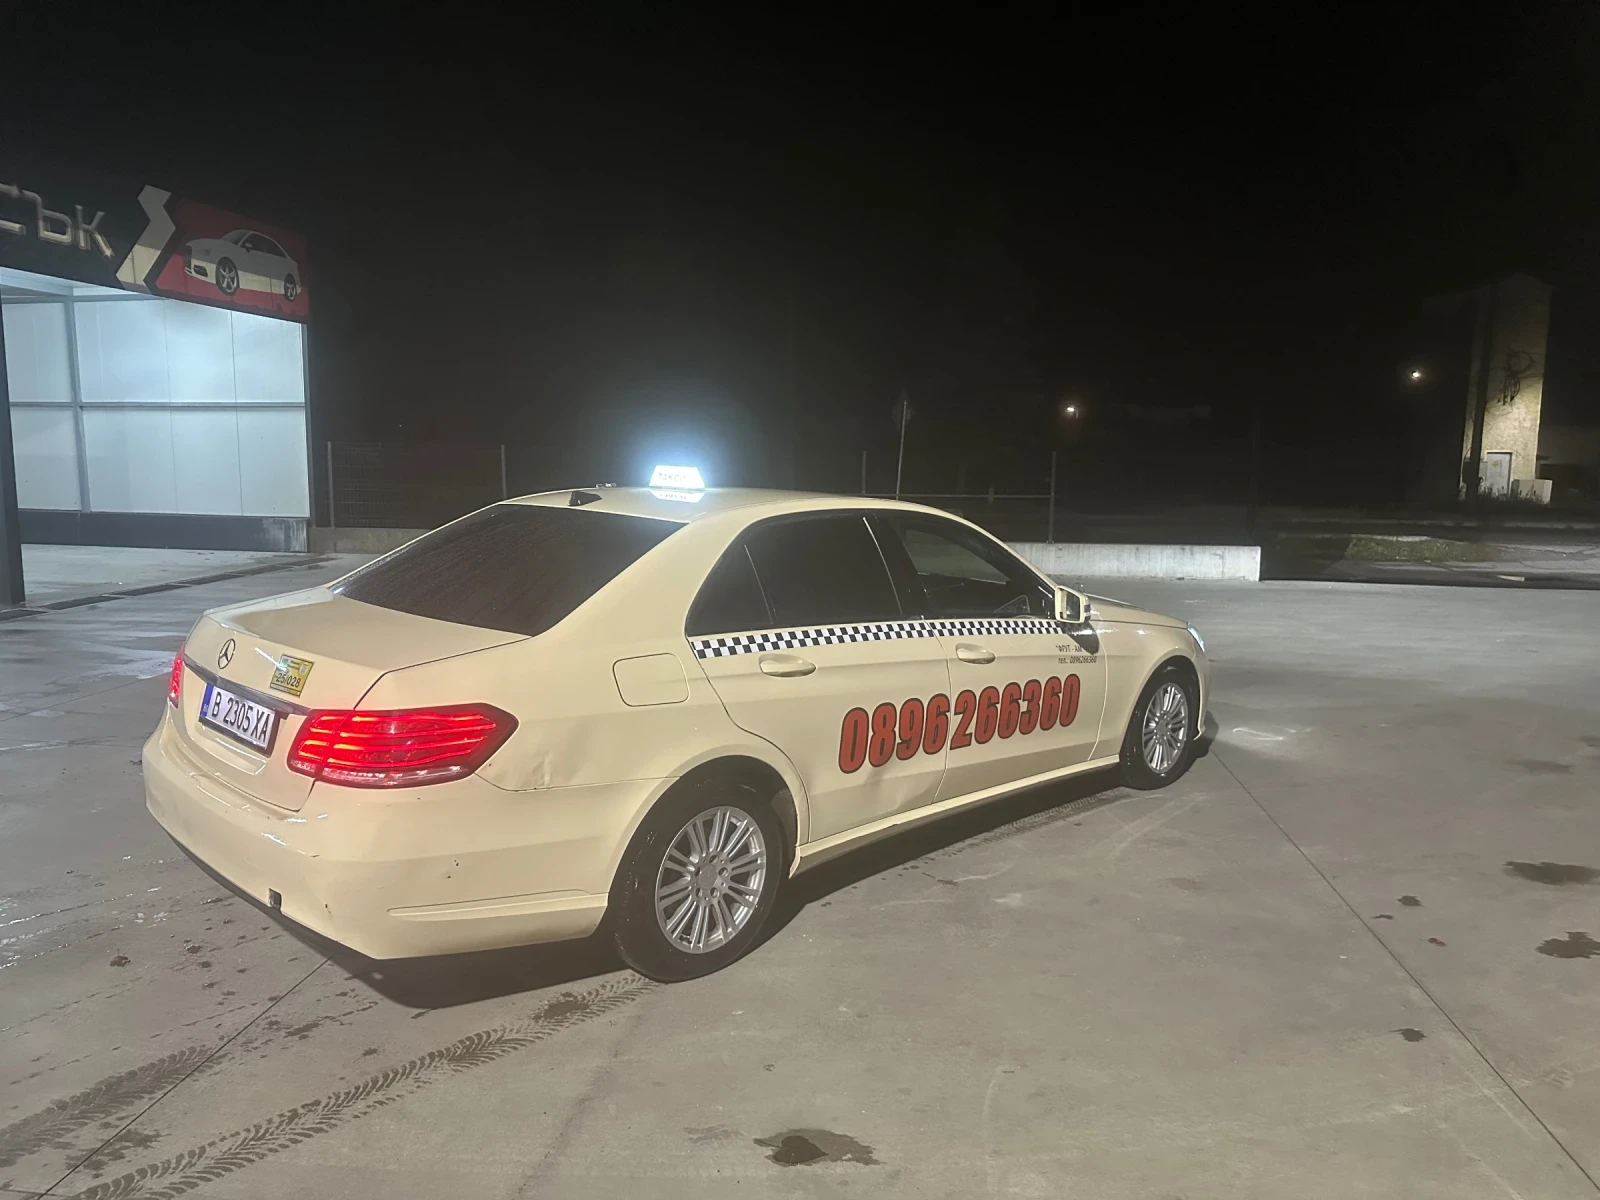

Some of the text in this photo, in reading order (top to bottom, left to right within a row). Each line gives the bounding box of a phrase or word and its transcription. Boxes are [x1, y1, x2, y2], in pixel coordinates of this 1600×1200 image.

[1070, 655, 1097, 664] 0896266360
[276, 673, 301, 688] 25/028
[211, 691, 271, 743] B 2305 XA
[838, 673, 1081, 774] 0896266360
